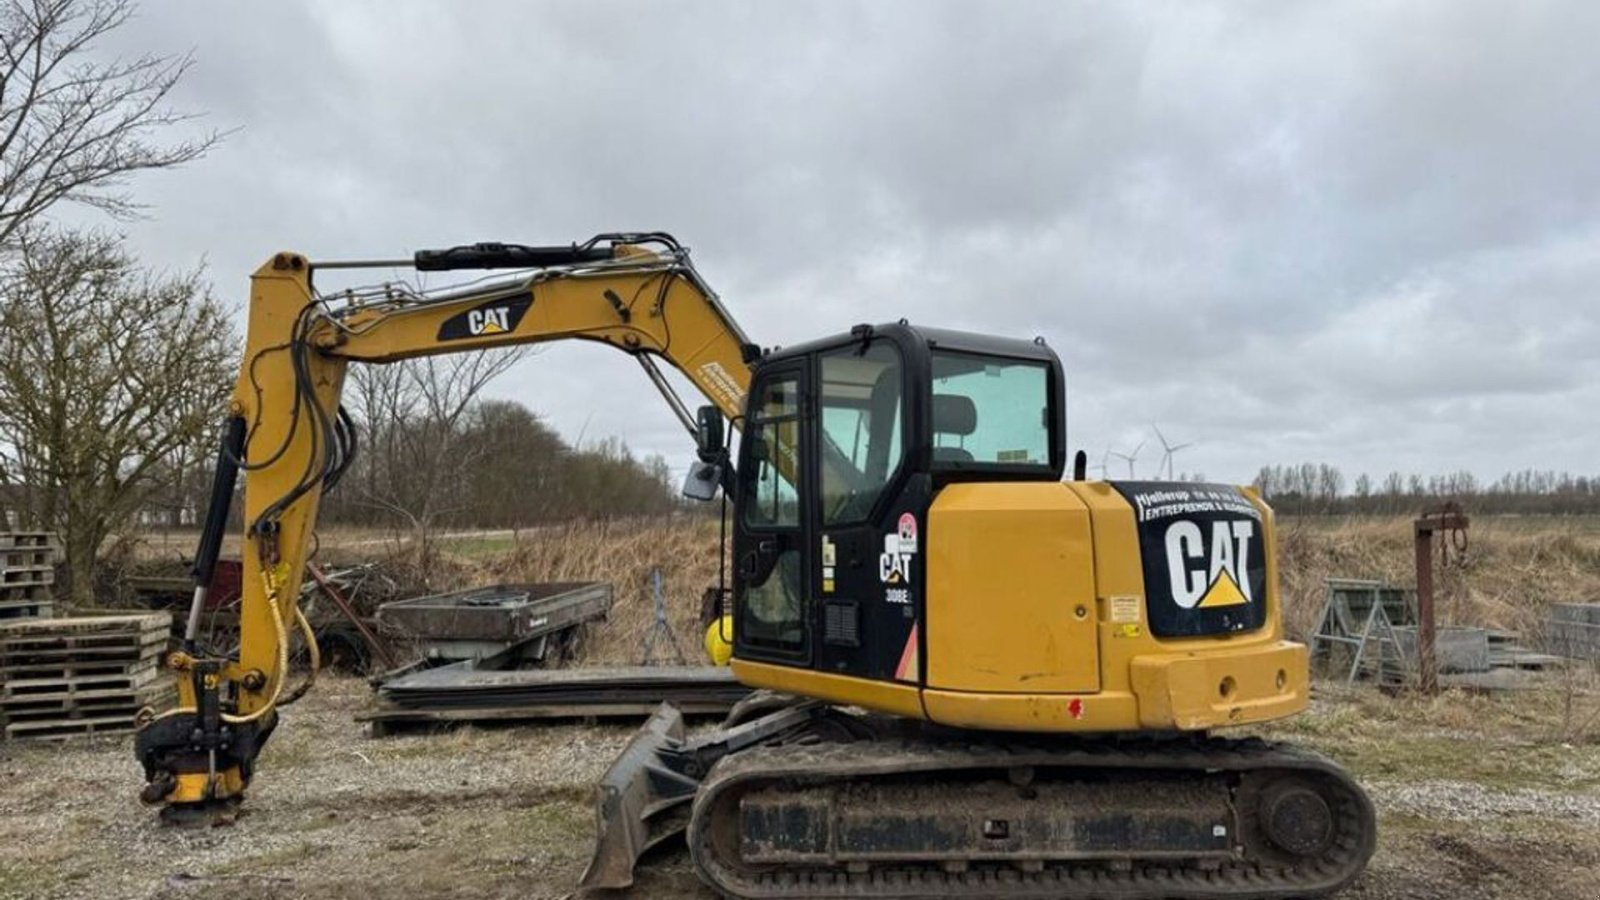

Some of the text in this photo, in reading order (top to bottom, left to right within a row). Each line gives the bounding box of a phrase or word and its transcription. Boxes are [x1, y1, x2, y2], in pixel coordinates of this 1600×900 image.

[468, 307, 510, 335] CAT
[880, 552, 911, 583] CAT
[1165, 520, 1254, 609] CAT
